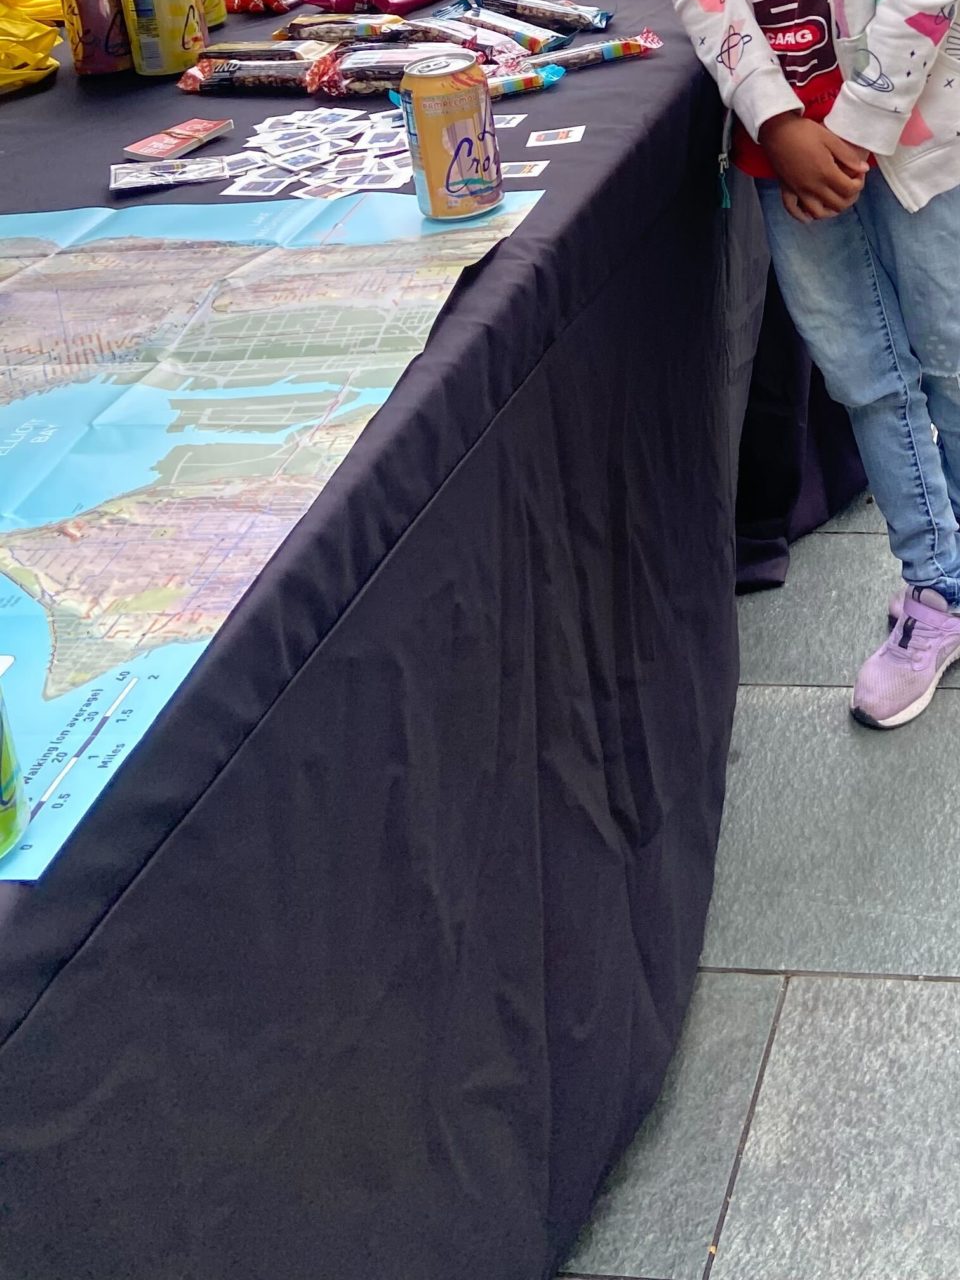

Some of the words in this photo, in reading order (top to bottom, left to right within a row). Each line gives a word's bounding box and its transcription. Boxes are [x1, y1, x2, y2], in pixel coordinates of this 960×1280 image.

[52, 751, 68, 764] 20
[83, 711, 100, 723] 30
[116, 670, 131, 682] 40
[67, 688, 104, 728] average)
[51, 793, 71, 810] 0.5
[116, 708, 134, 724] 1.5
[97, 742, 126, 770] Miles
